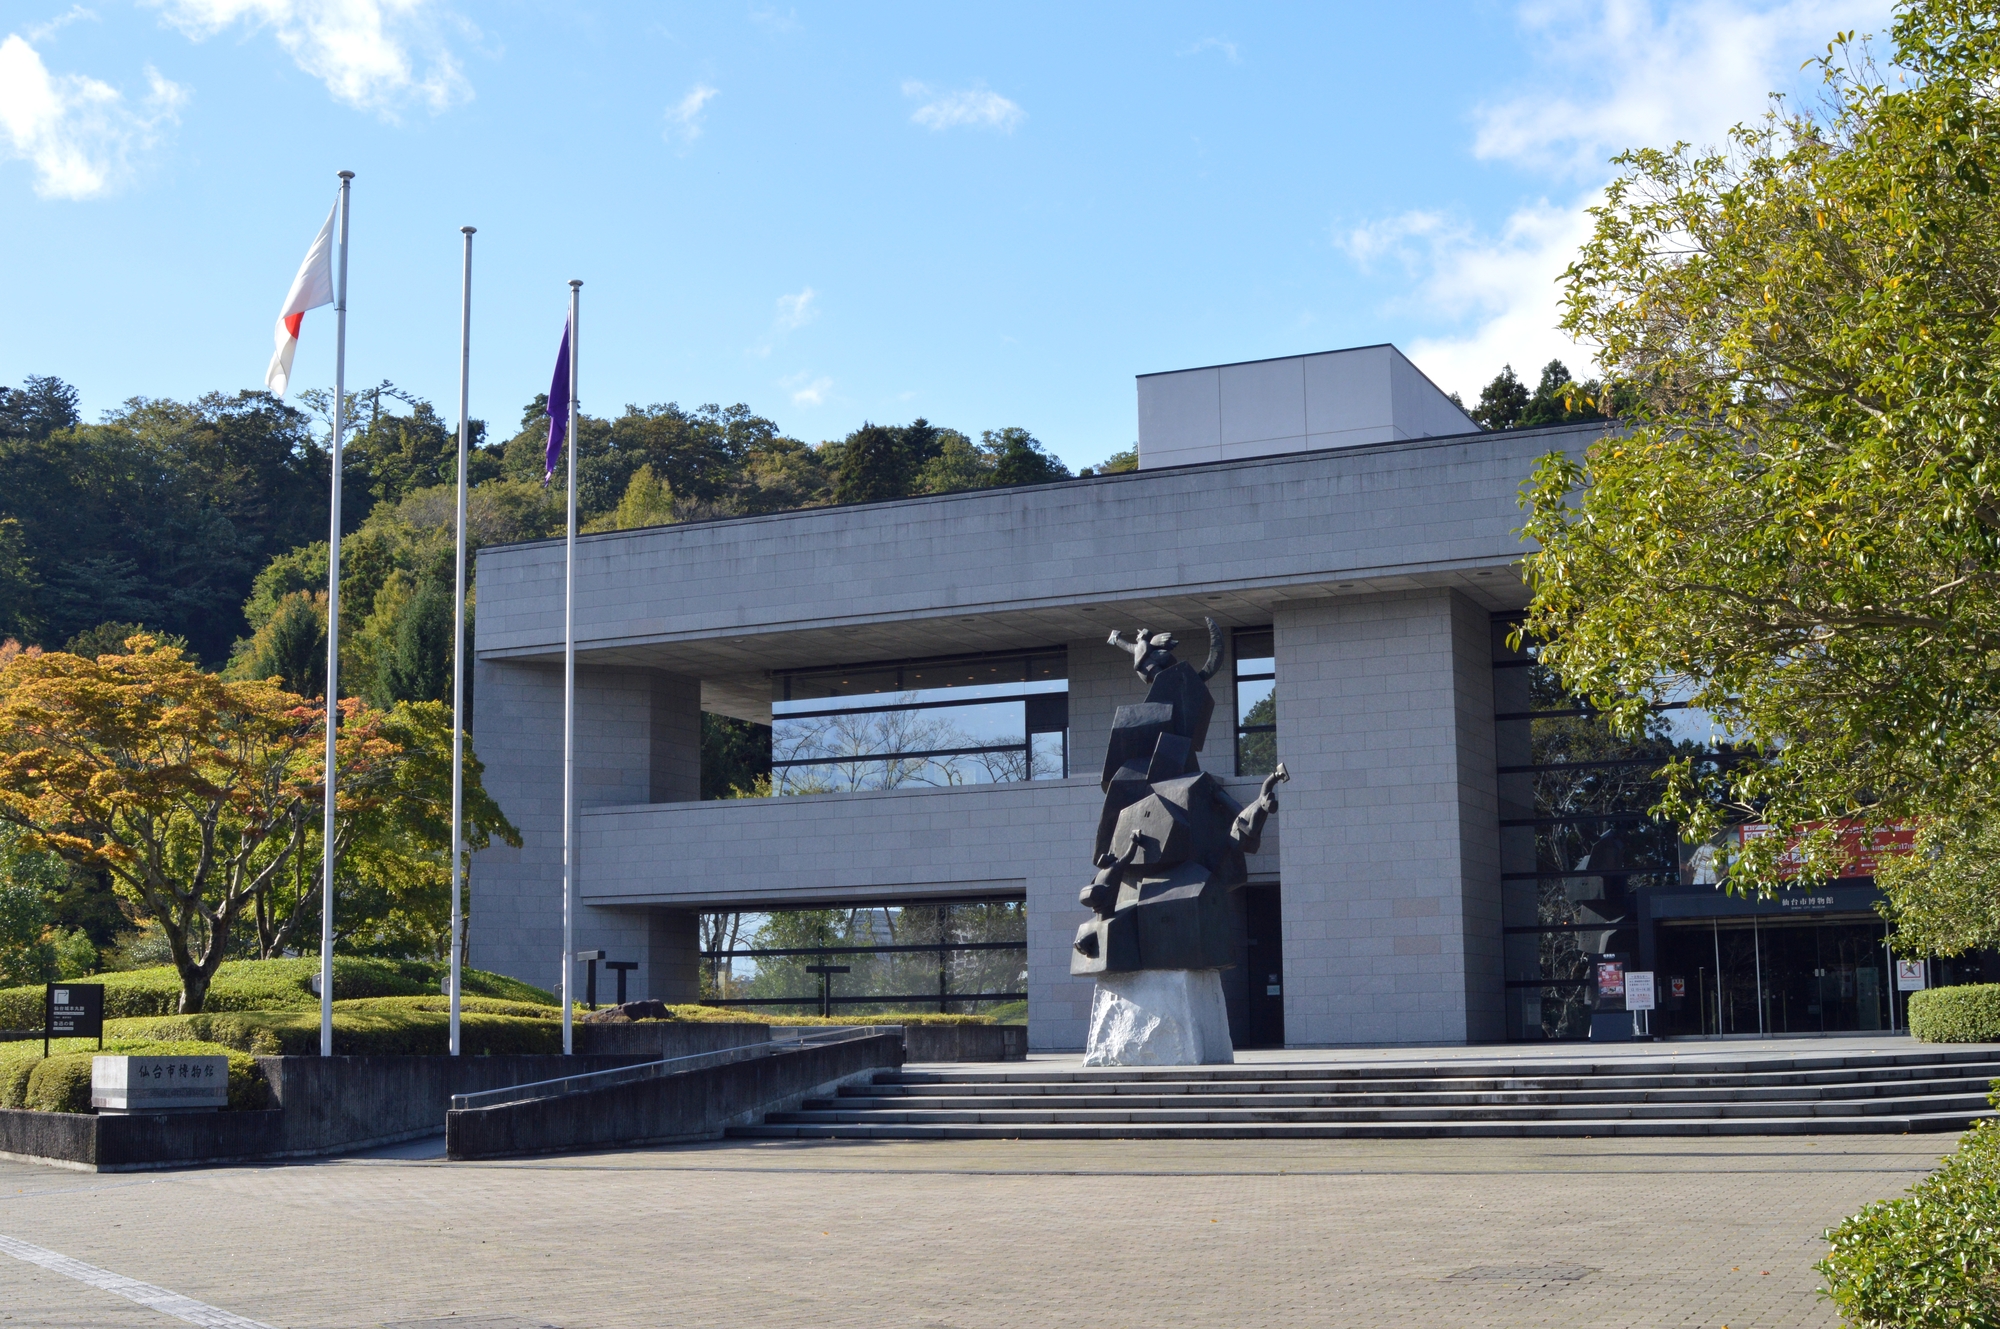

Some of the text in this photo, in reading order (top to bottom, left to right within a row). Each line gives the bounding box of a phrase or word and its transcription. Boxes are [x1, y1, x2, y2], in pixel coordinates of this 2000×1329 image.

[1782, 896, 1834, 906] 仙台市博物館
[138, 1063, 215, 1079] 仙台市博物館
